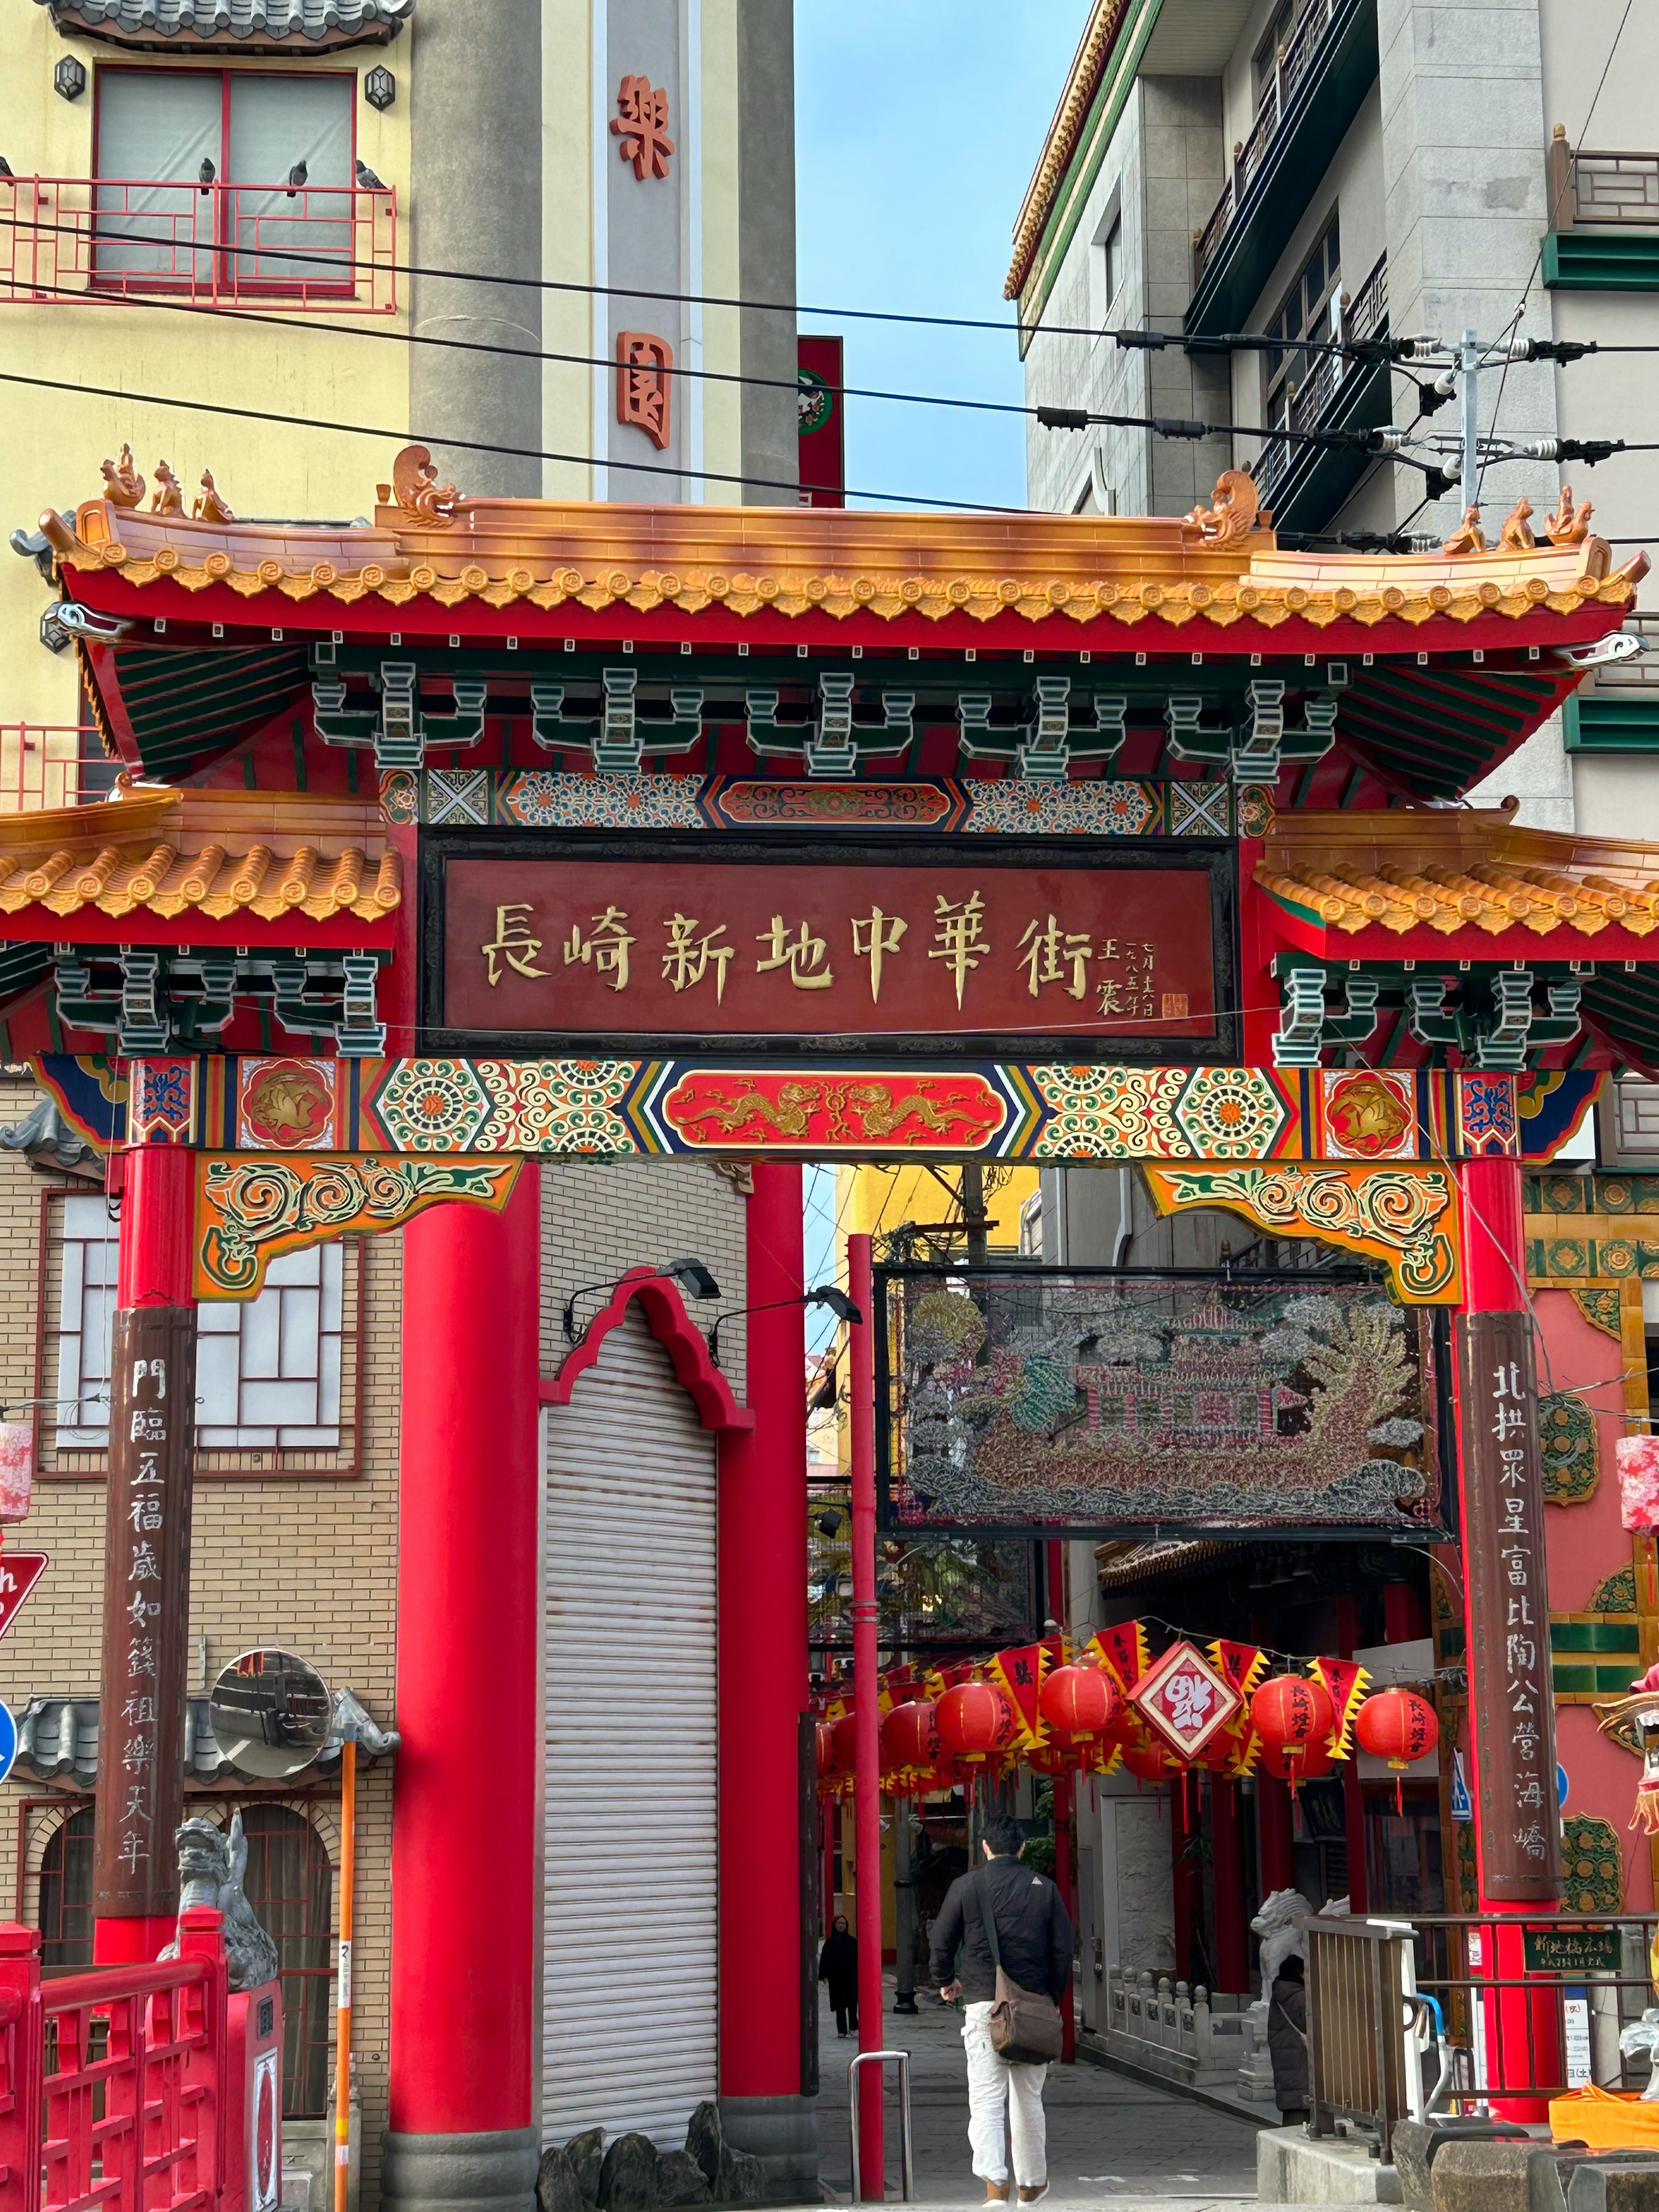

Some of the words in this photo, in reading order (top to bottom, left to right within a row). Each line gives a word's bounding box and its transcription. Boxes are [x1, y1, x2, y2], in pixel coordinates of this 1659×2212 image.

[481, 890, 1093, 1012] 長崎新地中華街
[1096, 938, 1125, 1016] 王震
[1125, 943, 1139, 1017] 一九八五年
[1141, 943, 1156, 1017] 七月十六日
